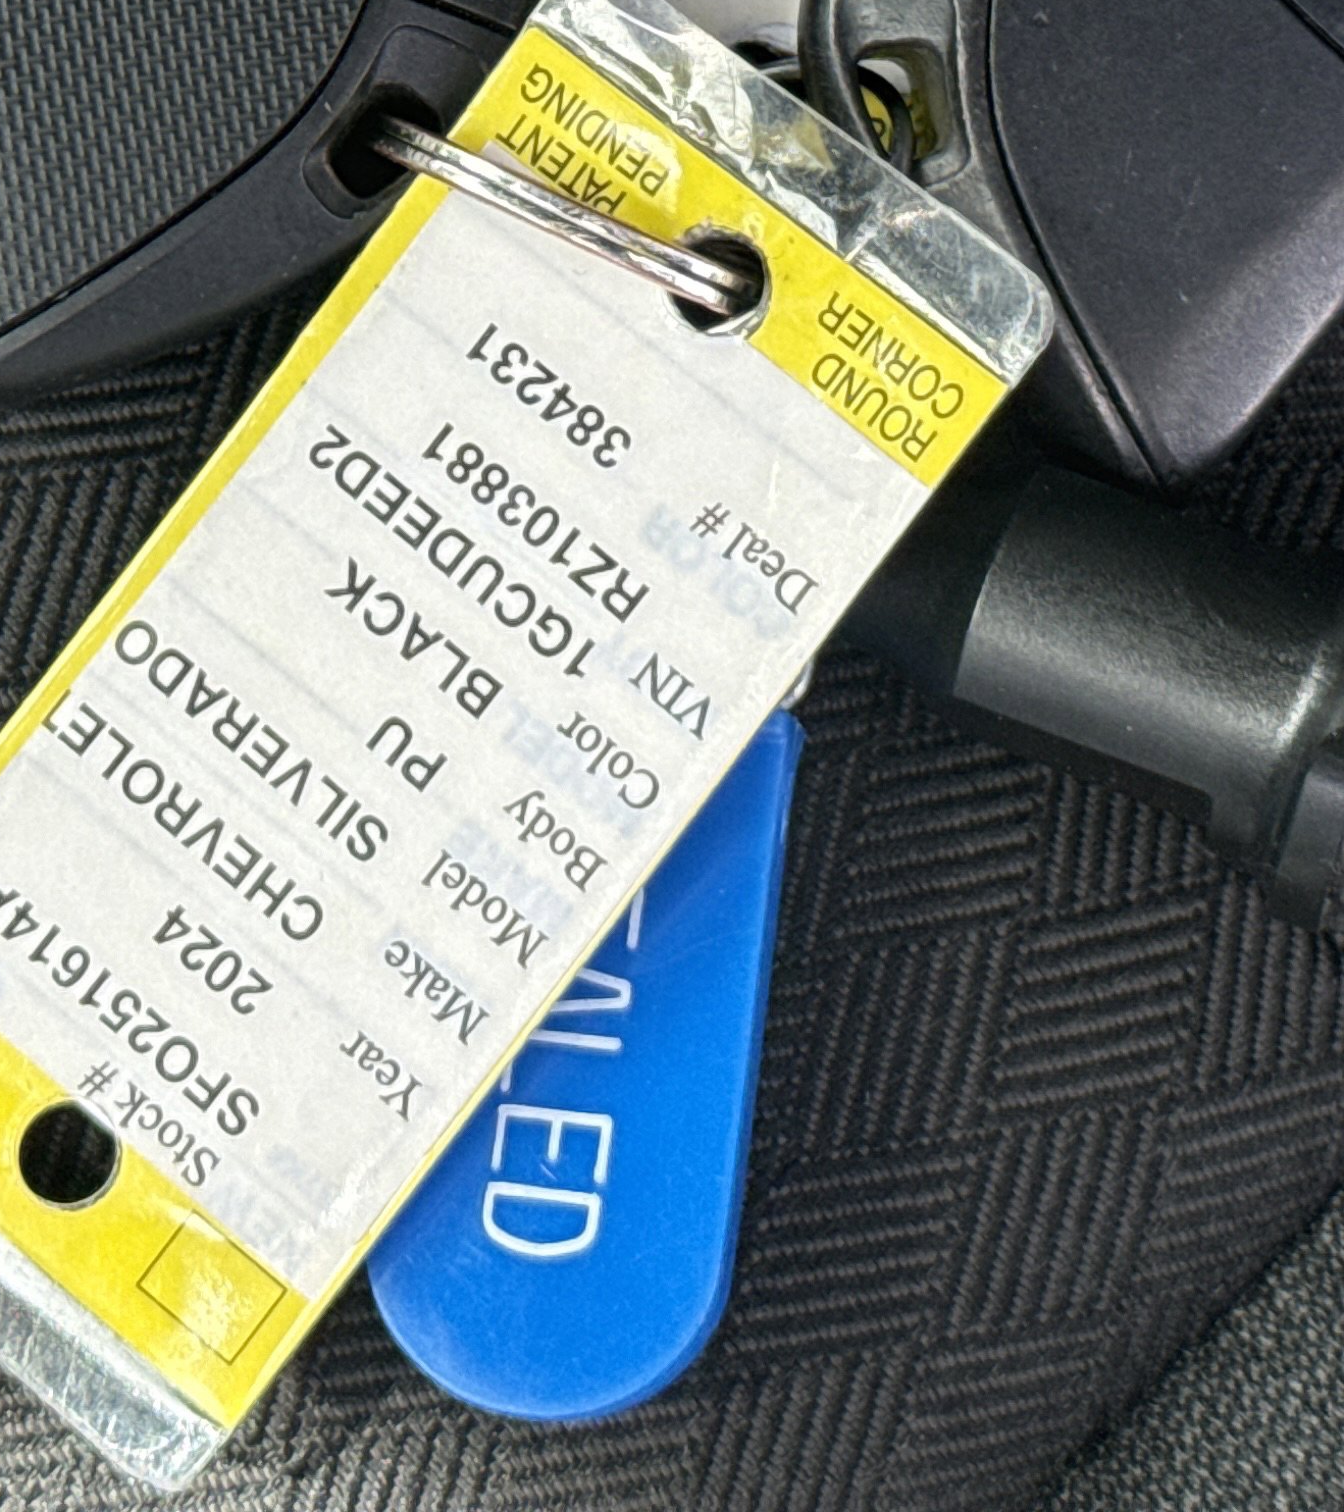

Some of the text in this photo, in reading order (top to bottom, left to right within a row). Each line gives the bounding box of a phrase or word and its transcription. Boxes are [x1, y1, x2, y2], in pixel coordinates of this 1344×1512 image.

[495, 114, 628, 220] PATENT
[521, 63, 669, 198] PENDING
[812, 354, 937, 462] ROUND
[818, 291, 963, 419] CORNER
[422, 423, 649, 623] RZ103881
[466, 323, 819, 616] Deal # 384231
[309, 424, 710, 740] VIN 1GCUDEED2
[115, 620, 388, 862] SILVERADO
[324, 557, 659, 809] Color BLACK
[366, 716, 447, 792] PU
[503, 791, 608, 893] Body
[422, 850, 549, 969] Model
[153, 905, 422, 1122] Year 2024
[385, 941, 489, 1046] Make
[78, 1062, 118, 1098] #
[115, 1082, 220, 1186] Stock
